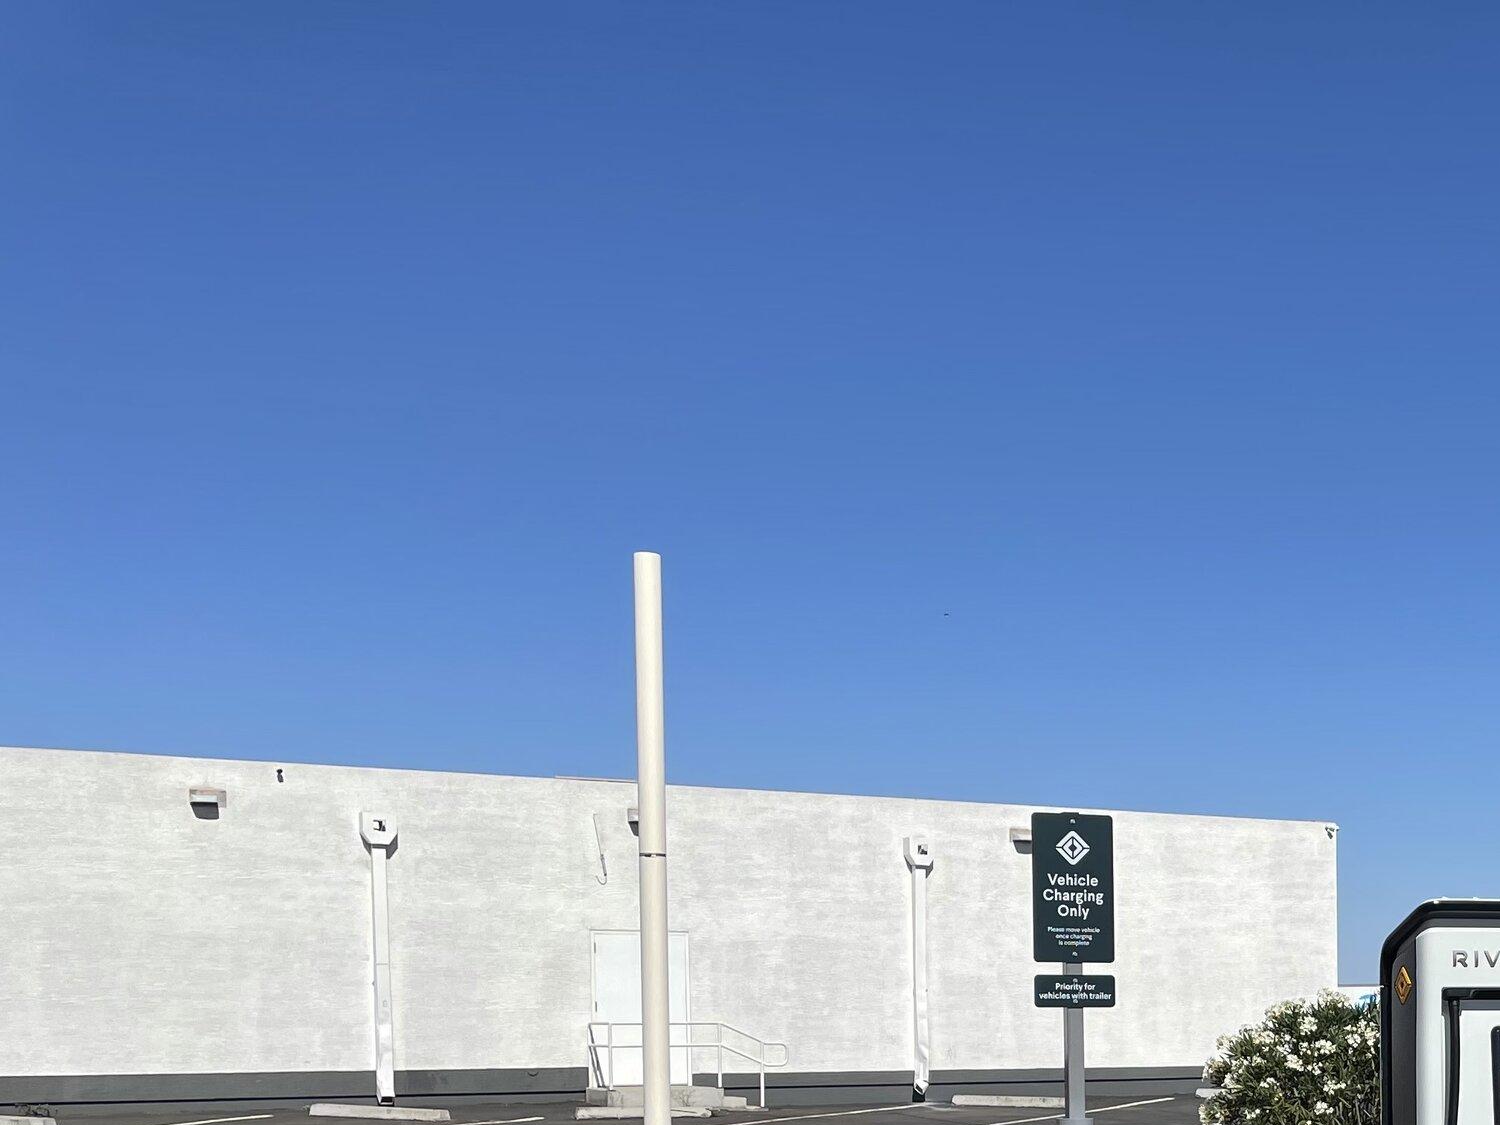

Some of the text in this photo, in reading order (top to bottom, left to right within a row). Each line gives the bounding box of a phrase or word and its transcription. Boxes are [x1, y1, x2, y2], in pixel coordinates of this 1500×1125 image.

[1047, 873, 1099, 887] Vehicle
[1042, 888, 1104, 905] Charging
[1057, 904, 1090, 920] Only
[1055, 982, 1096, 992] Priority for
[1038, 991, 1112, 1000] vehicles with trailer
